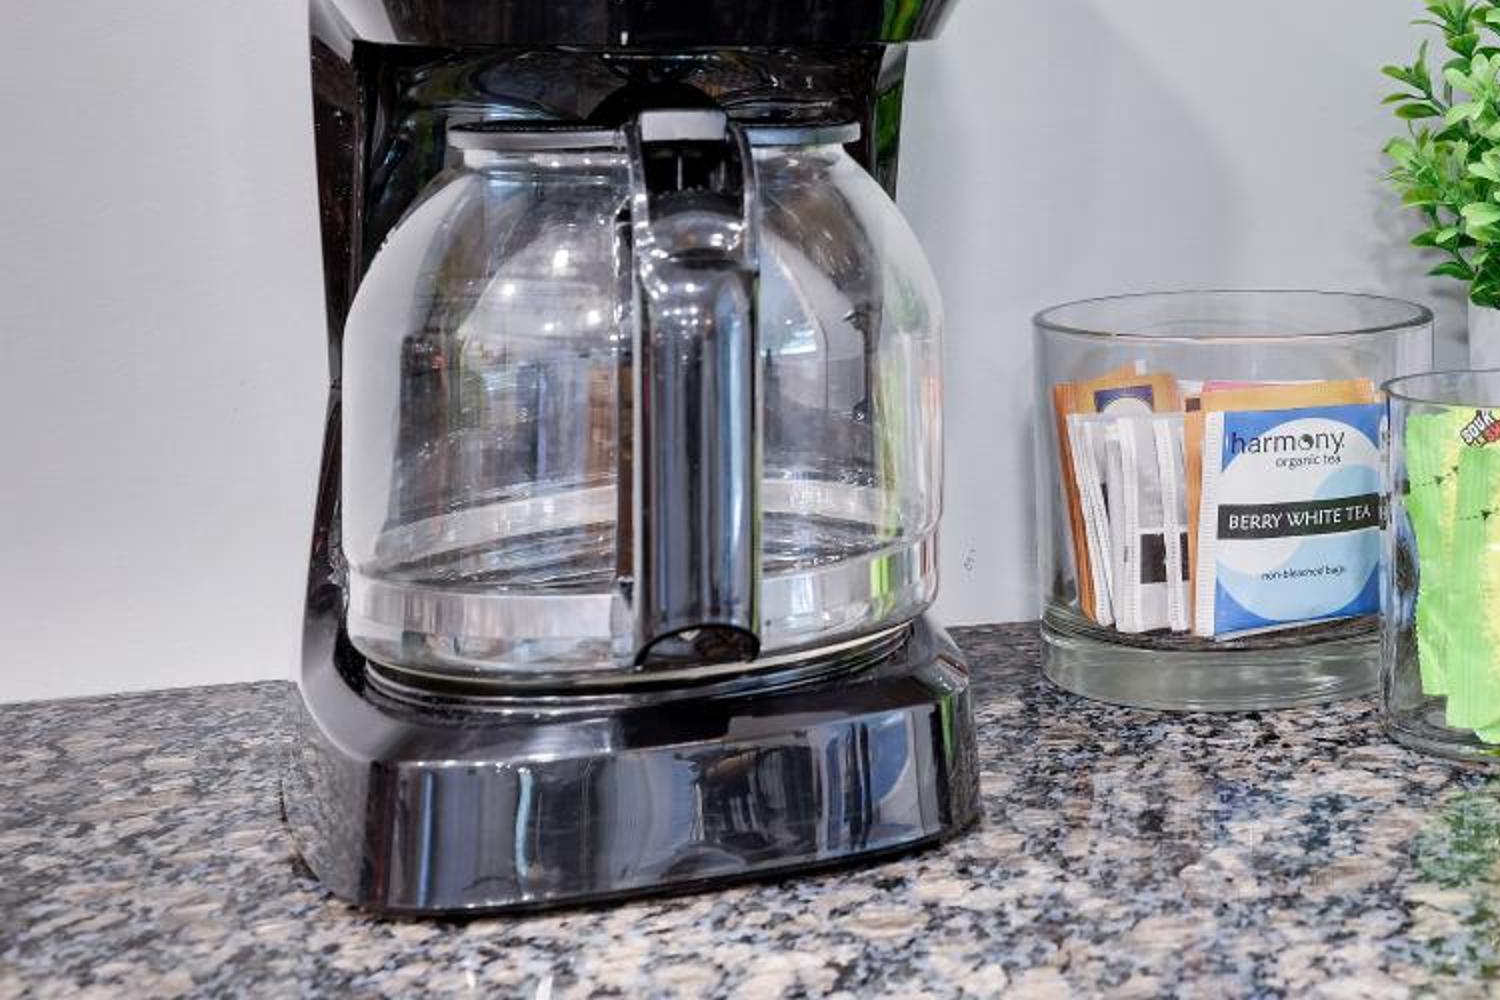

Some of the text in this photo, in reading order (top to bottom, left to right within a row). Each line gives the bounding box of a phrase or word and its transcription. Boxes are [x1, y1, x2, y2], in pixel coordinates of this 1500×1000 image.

[1231, 431, 1344, 455] harmony
[1275, 454, 1342, 470] organic tea
[1229, 504, 1371, 530] BERRY WHITE TEA
